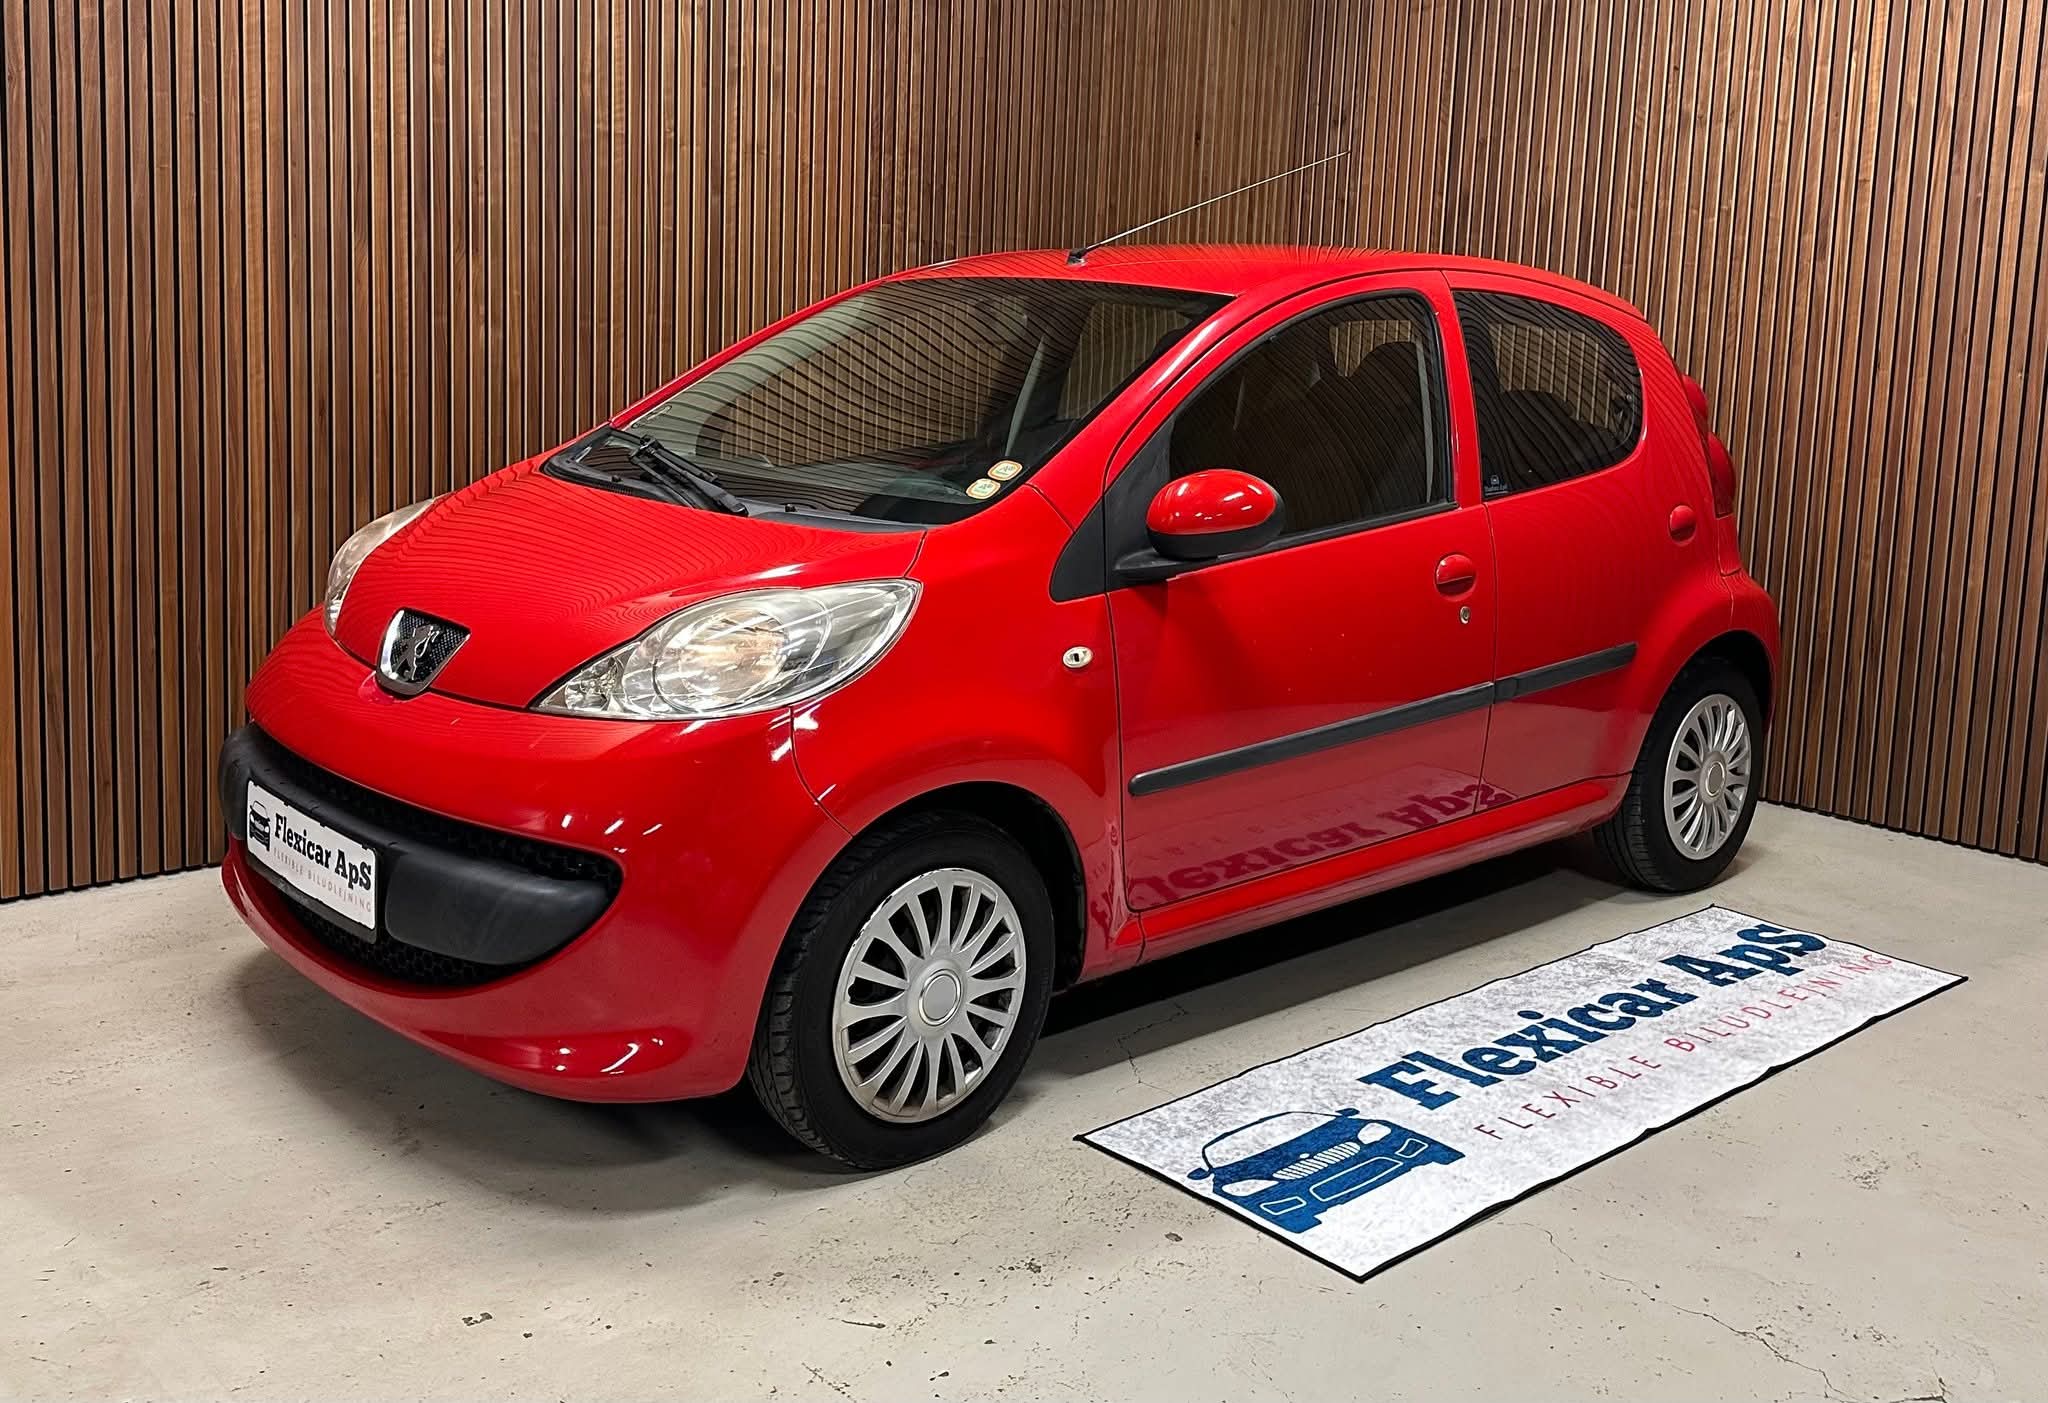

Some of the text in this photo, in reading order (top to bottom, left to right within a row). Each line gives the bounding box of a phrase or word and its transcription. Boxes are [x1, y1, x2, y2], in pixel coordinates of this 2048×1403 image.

[274, 812, 372, 891] Flexicar ApS
[1356, 923, 1827, 1111] Flexicar ApS
[1473, 954, 1893, 1140] FLEXIBLE BILUDLEJNING
